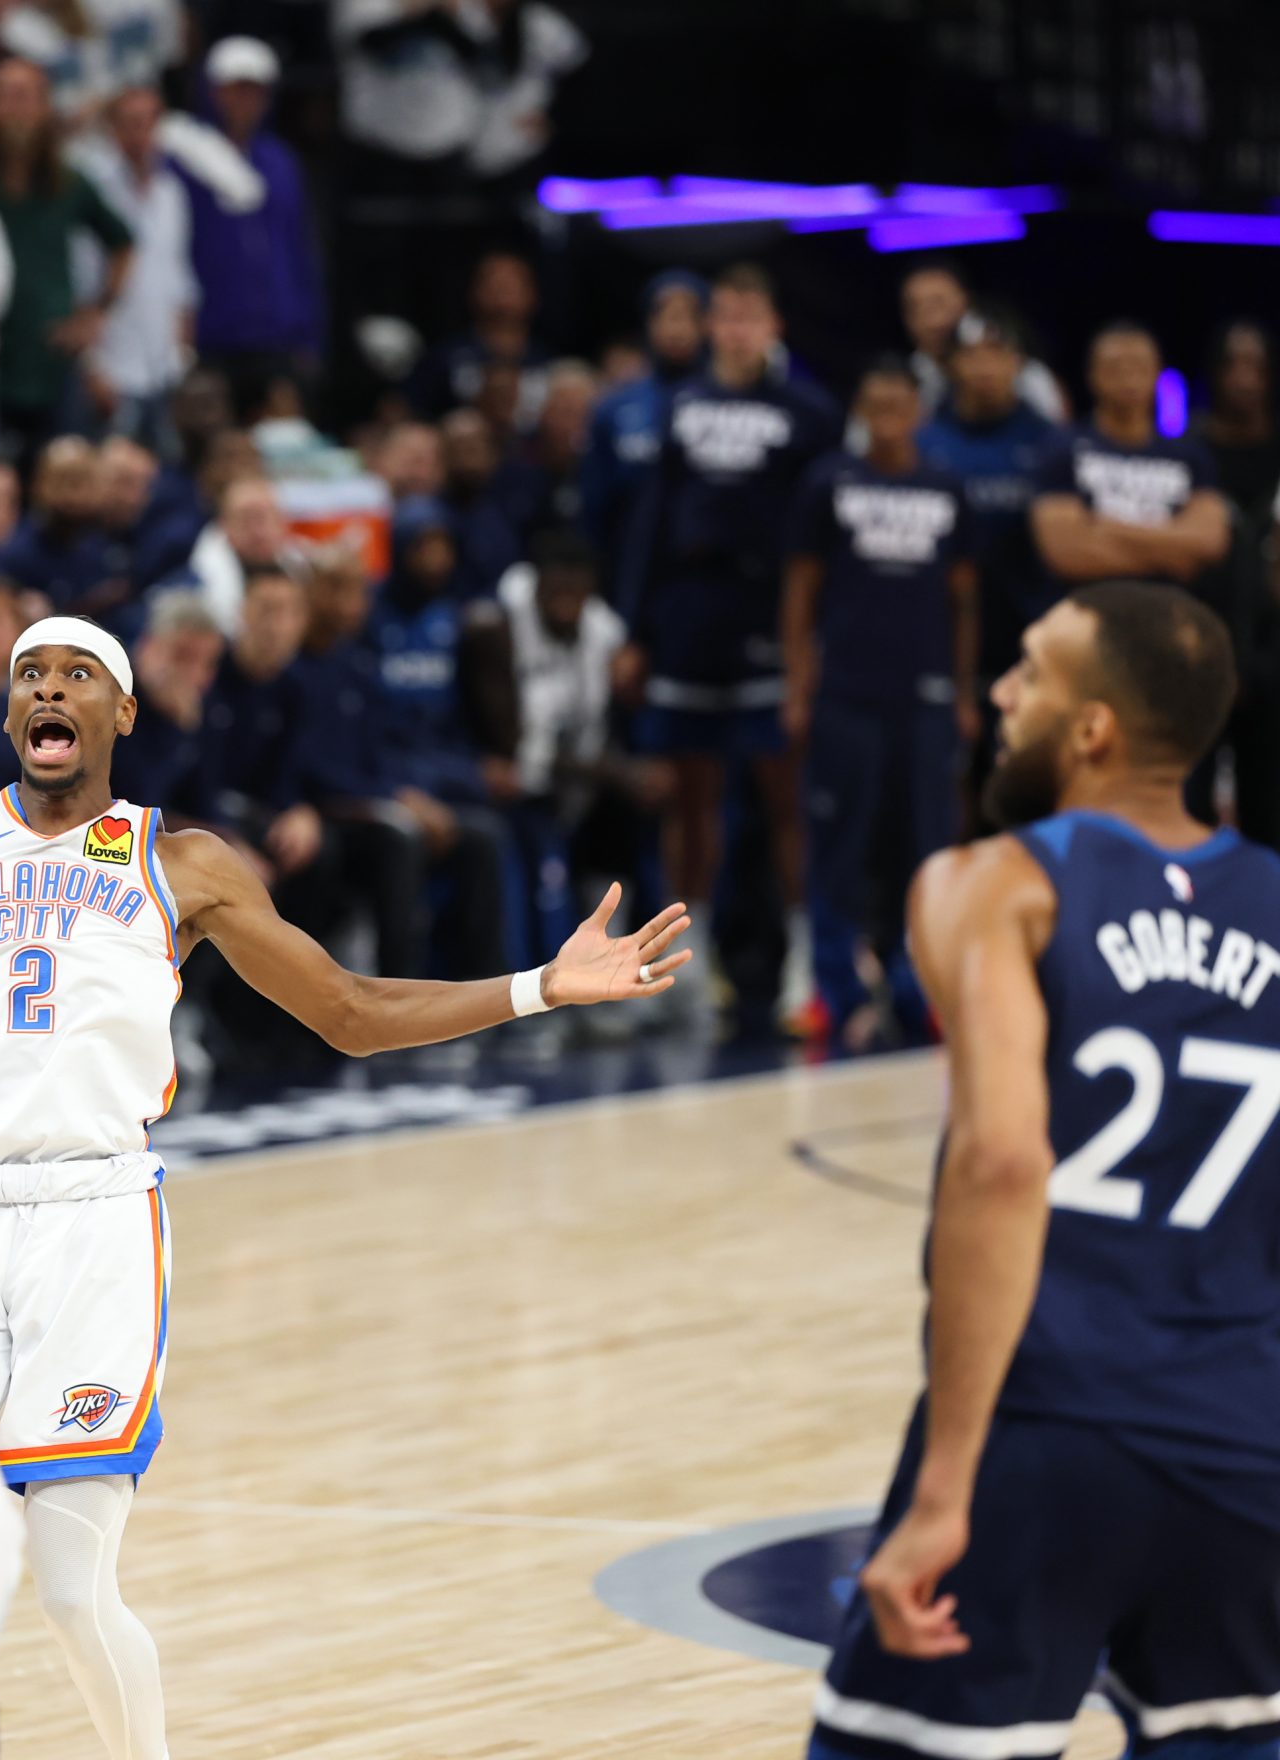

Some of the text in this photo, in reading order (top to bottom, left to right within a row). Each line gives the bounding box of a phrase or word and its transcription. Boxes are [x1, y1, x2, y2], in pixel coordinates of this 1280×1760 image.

[7, 945, 56, 1033] 2
[1096, 908, 1280, 1010] GOBERT
[1046, 1025, 1280, 1230] 27
